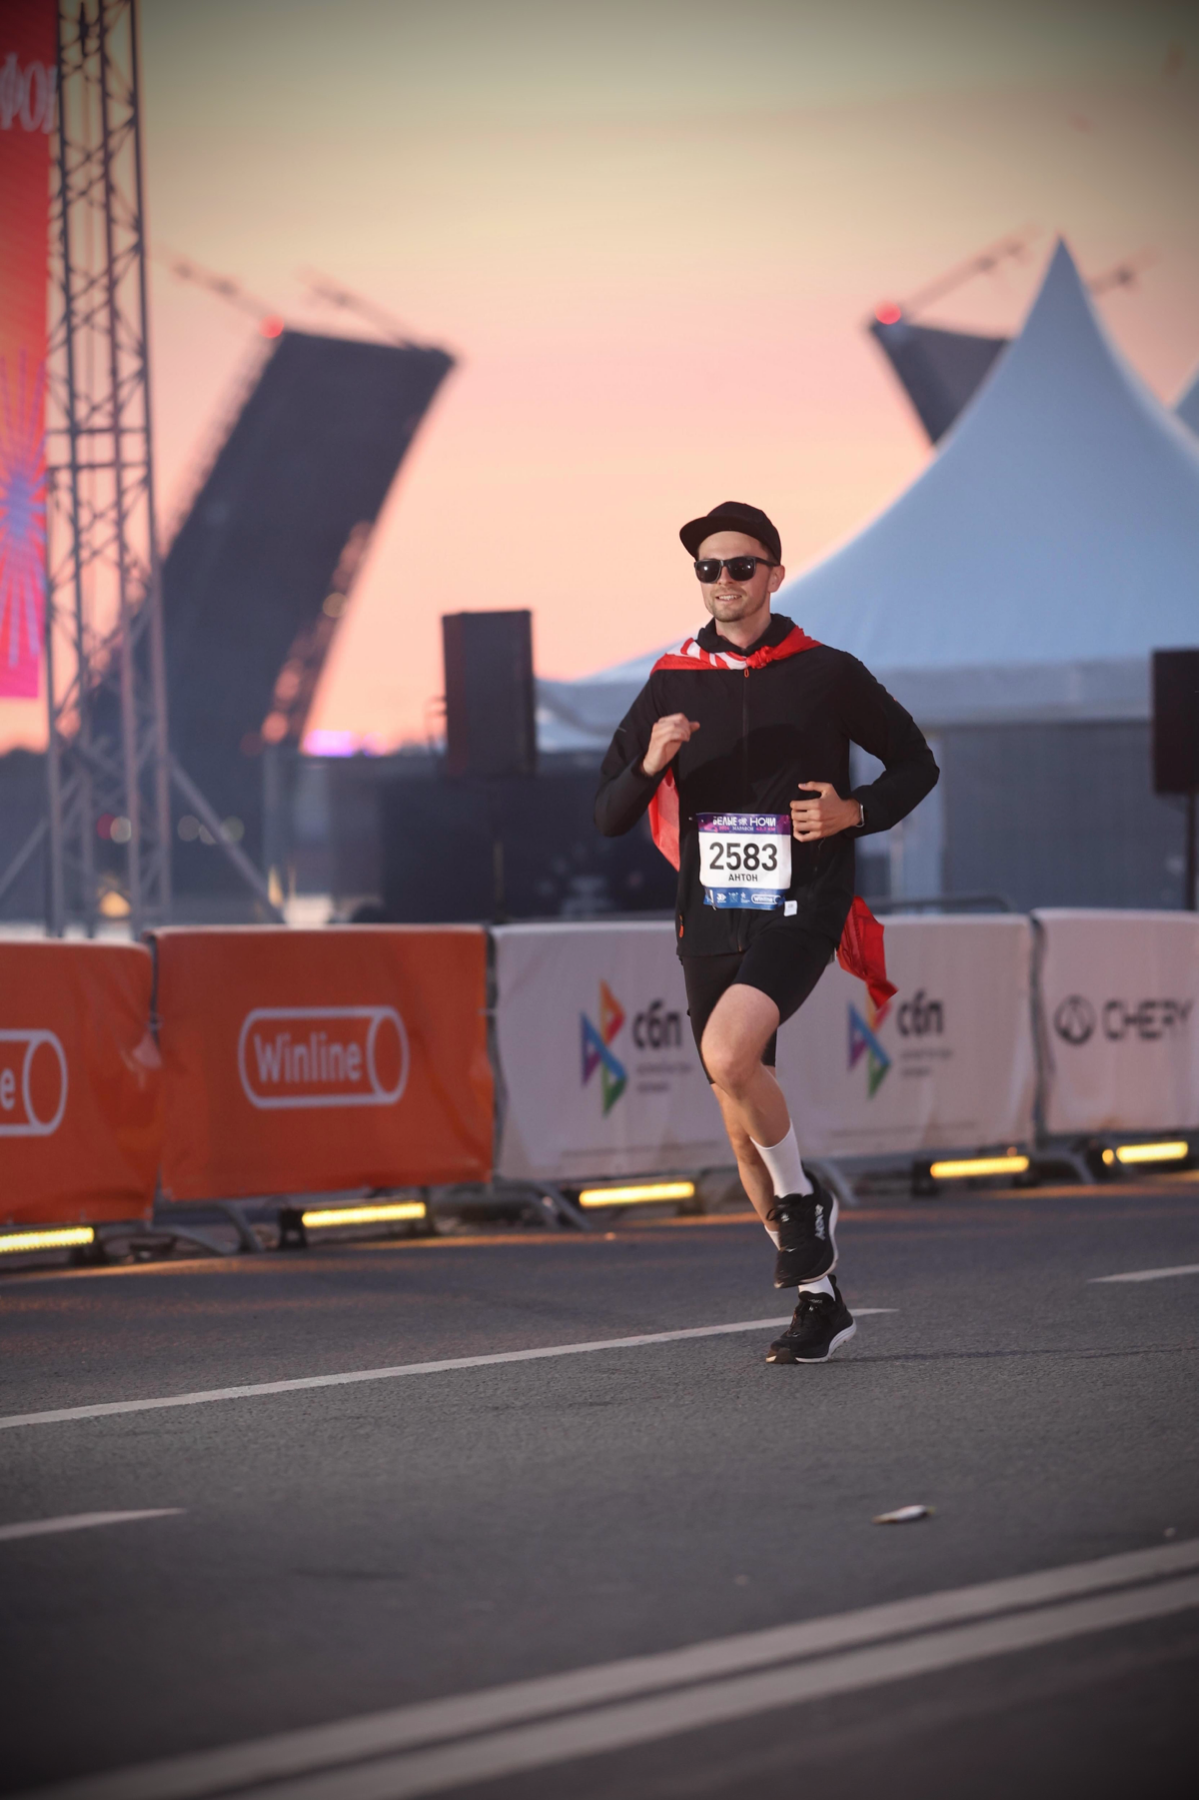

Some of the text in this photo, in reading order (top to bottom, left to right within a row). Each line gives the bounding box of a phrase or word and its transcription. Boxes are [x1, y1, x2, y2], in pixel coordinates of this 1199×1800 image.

[749, 817, 777, 827] НОЧИ
[709, 841, 778, 872] 2583
[728, 873, 759, 882] АНТОН
[253, 1031, 363, 1085] Winline
